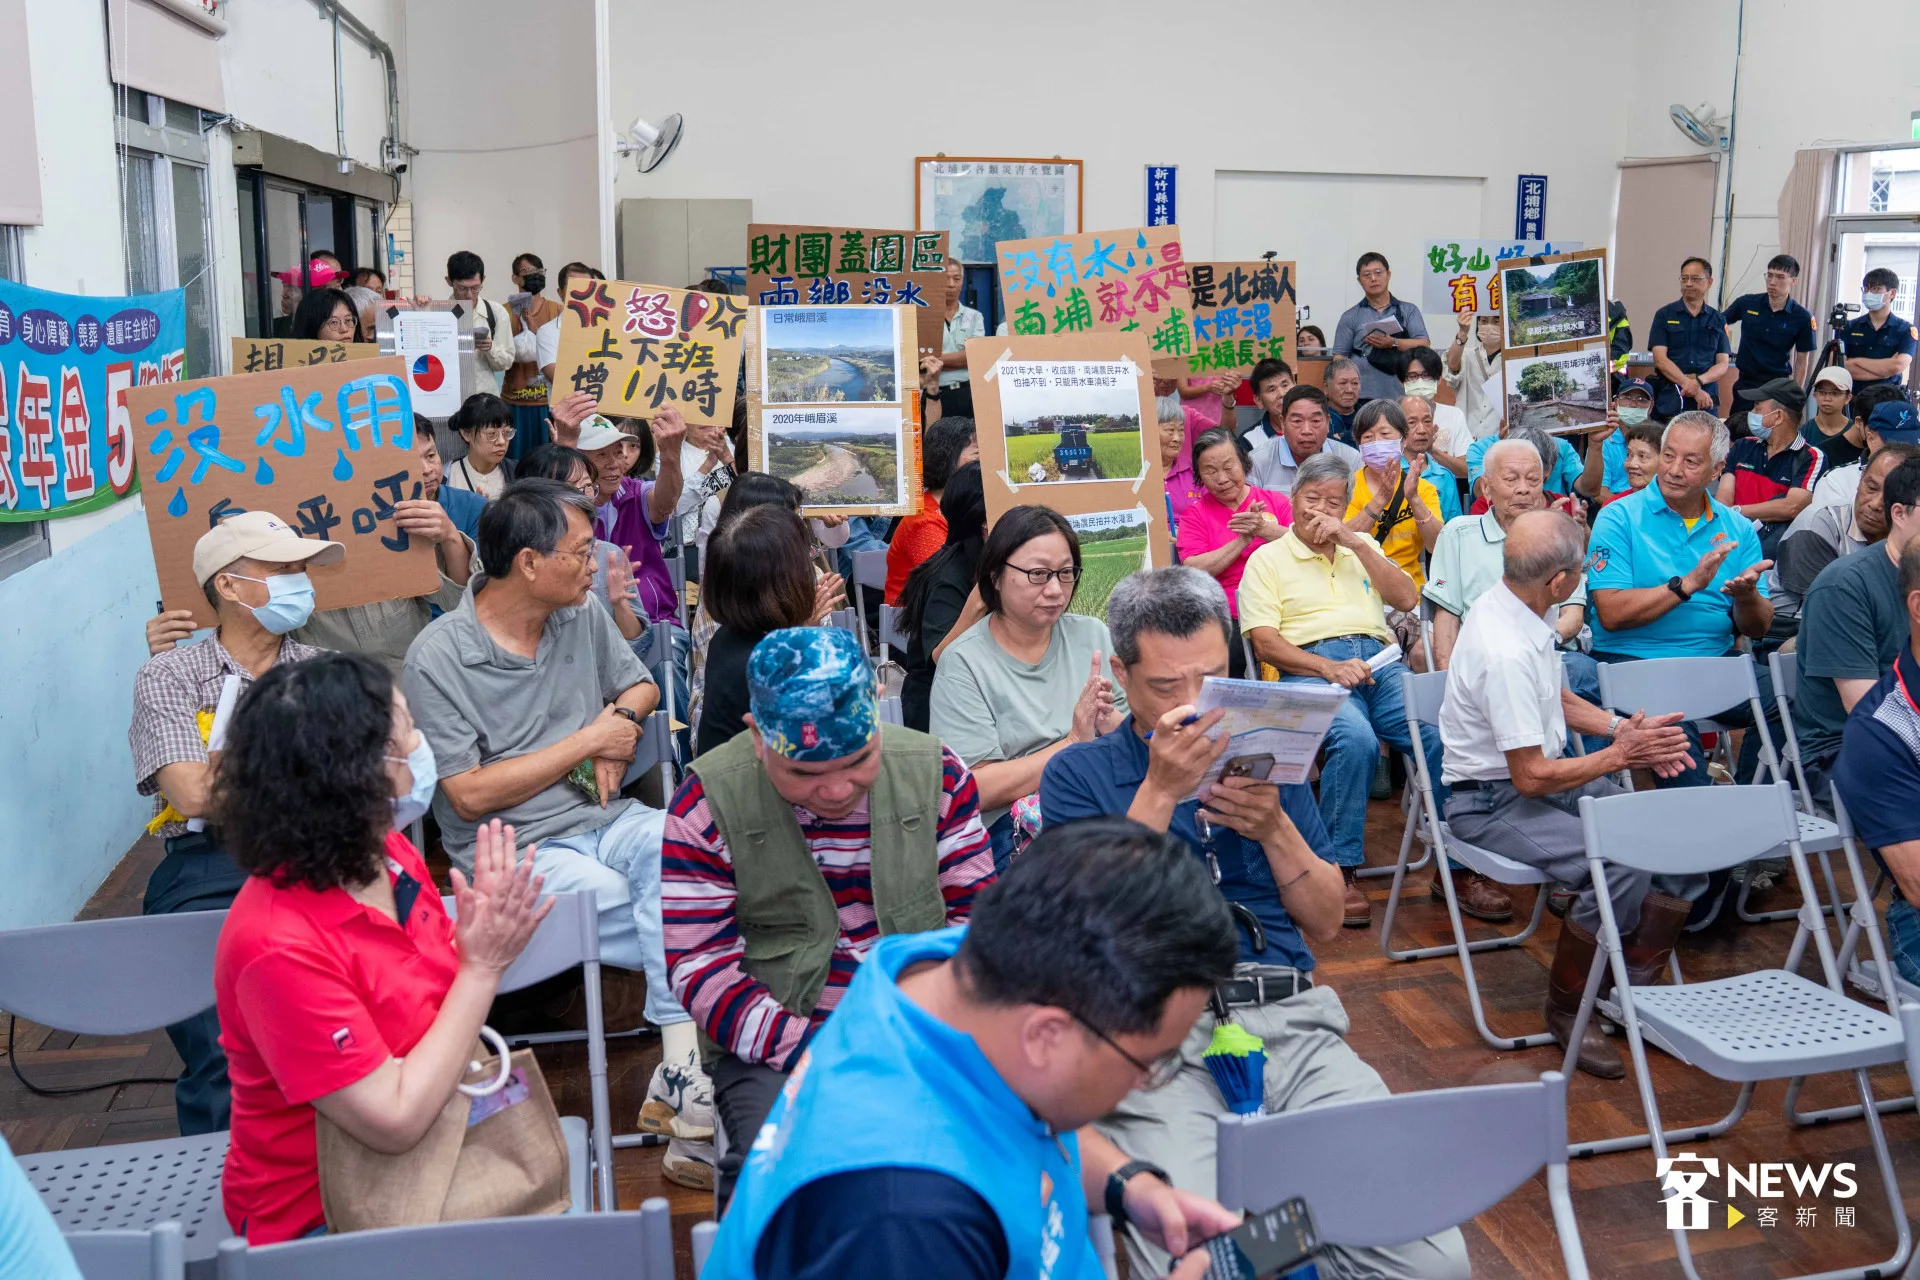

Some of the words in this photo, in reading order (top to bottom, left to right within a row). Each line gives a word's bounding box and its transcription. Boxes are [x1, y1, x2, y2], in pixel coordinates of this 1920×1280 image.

[1523, 182, 1542, 220] 北埔鄉
[749, 230, 946, 279] 財團蓋園區
[1003, 238, 1129, 293] 沒有水
[1096, 241, 1189, 324] 就不是
[1185, 263, 1296, 310] 是北埔人
[22, 314, 70, 347] 身心障礙
[78, 322, 98, 348] 喪葬
[106, 316, 156, 346] 遺屬年金給付
[773, 311, 828, 324] 日常峨眉溪
[587, 328, 716, 375] 上下班
[1187, 336, 1286, 373] 永續長流
[570, 361, 722, 418] 增1小時
[145, 373, 415, 485] 沒水用
[772, 412, 838, 424] 2020年峨眉溪
[209, 470, 423, 552] 呼呼
